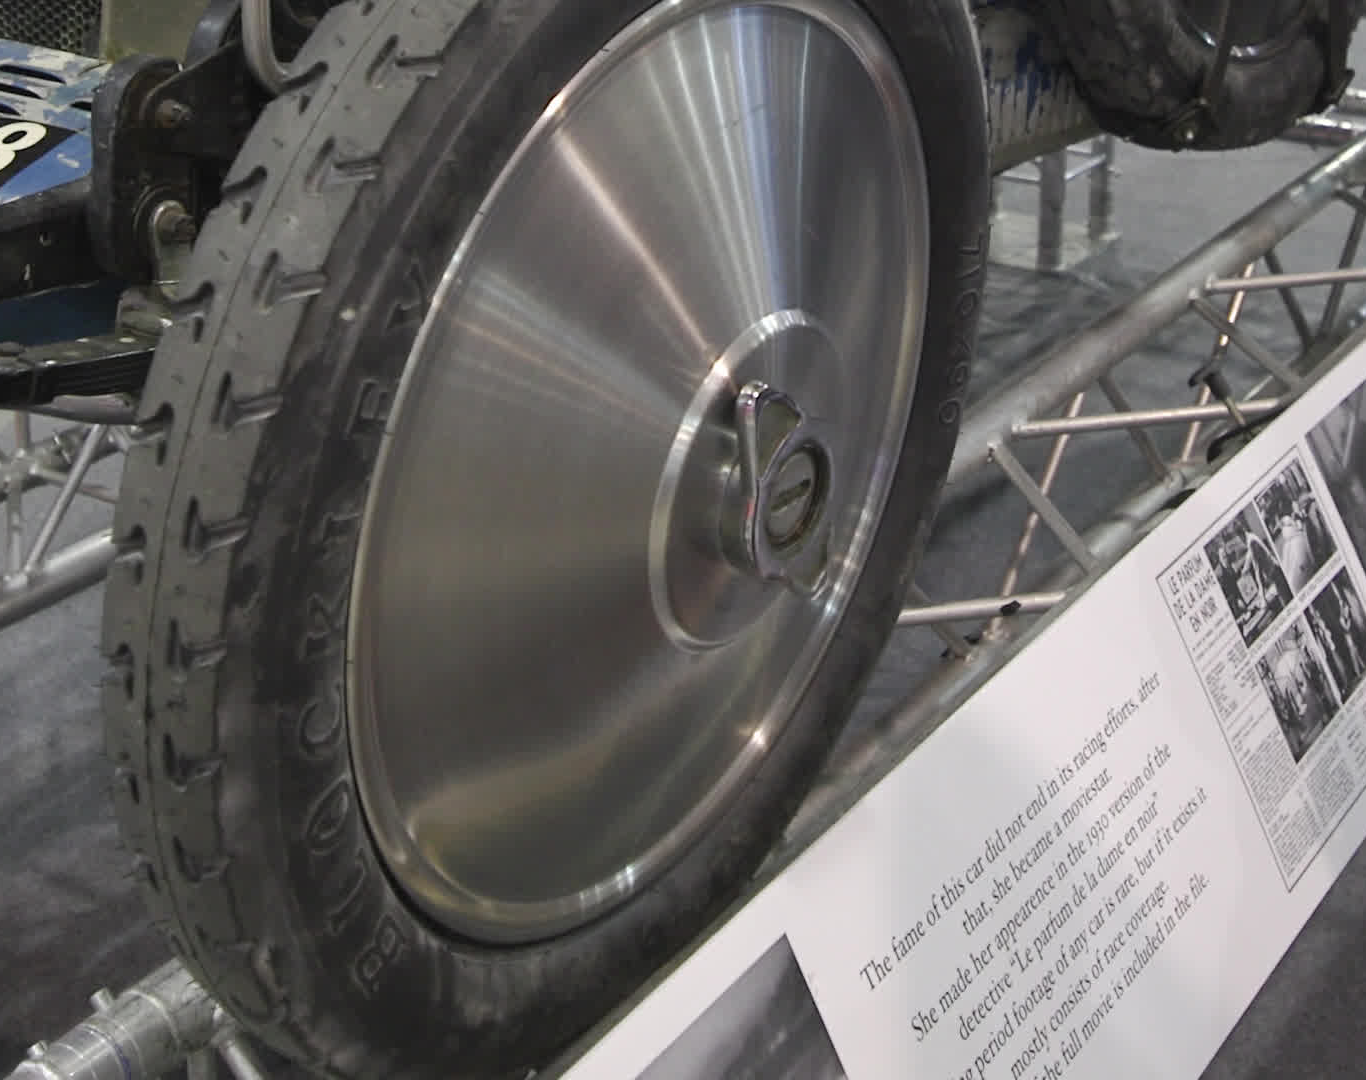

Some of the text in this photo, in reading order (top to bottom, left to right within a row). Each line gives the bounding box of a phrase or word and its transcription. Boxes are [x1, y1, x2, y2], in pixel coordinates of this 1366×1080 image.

[859, 672, 1161, 992] The fame of this car did not end in its racing efforts, after
[911, 743, 1172, 1042] She made her appearence in the 1930 version of the
[958, 973, 1012, 1041] detective
[1033, 902, 1073, 961] parfum
[1071, 884, 1087, 908] de
[1084, 872, 1099, 893] la
[1097, 840, 1125, 879] dame
[1124, 826, 1139, 847] en
[963, 768, 1113, 936] that, she became a moviestar.
[974, 784, 1208, 1080] period footage of any car is rare, but if it exists it
[1010, 880, 1170, 1080] mostly consists of race coverage.
[1061, 1027, 1083, 1065] full
[1081, 993, 1115, 1042] movie
[1112, 980, 1125, 1001] is
[1122, 920, 1166, 988] included
[1162, 913, 1177, 936] in
[1173, 894, 1192, 921] the
